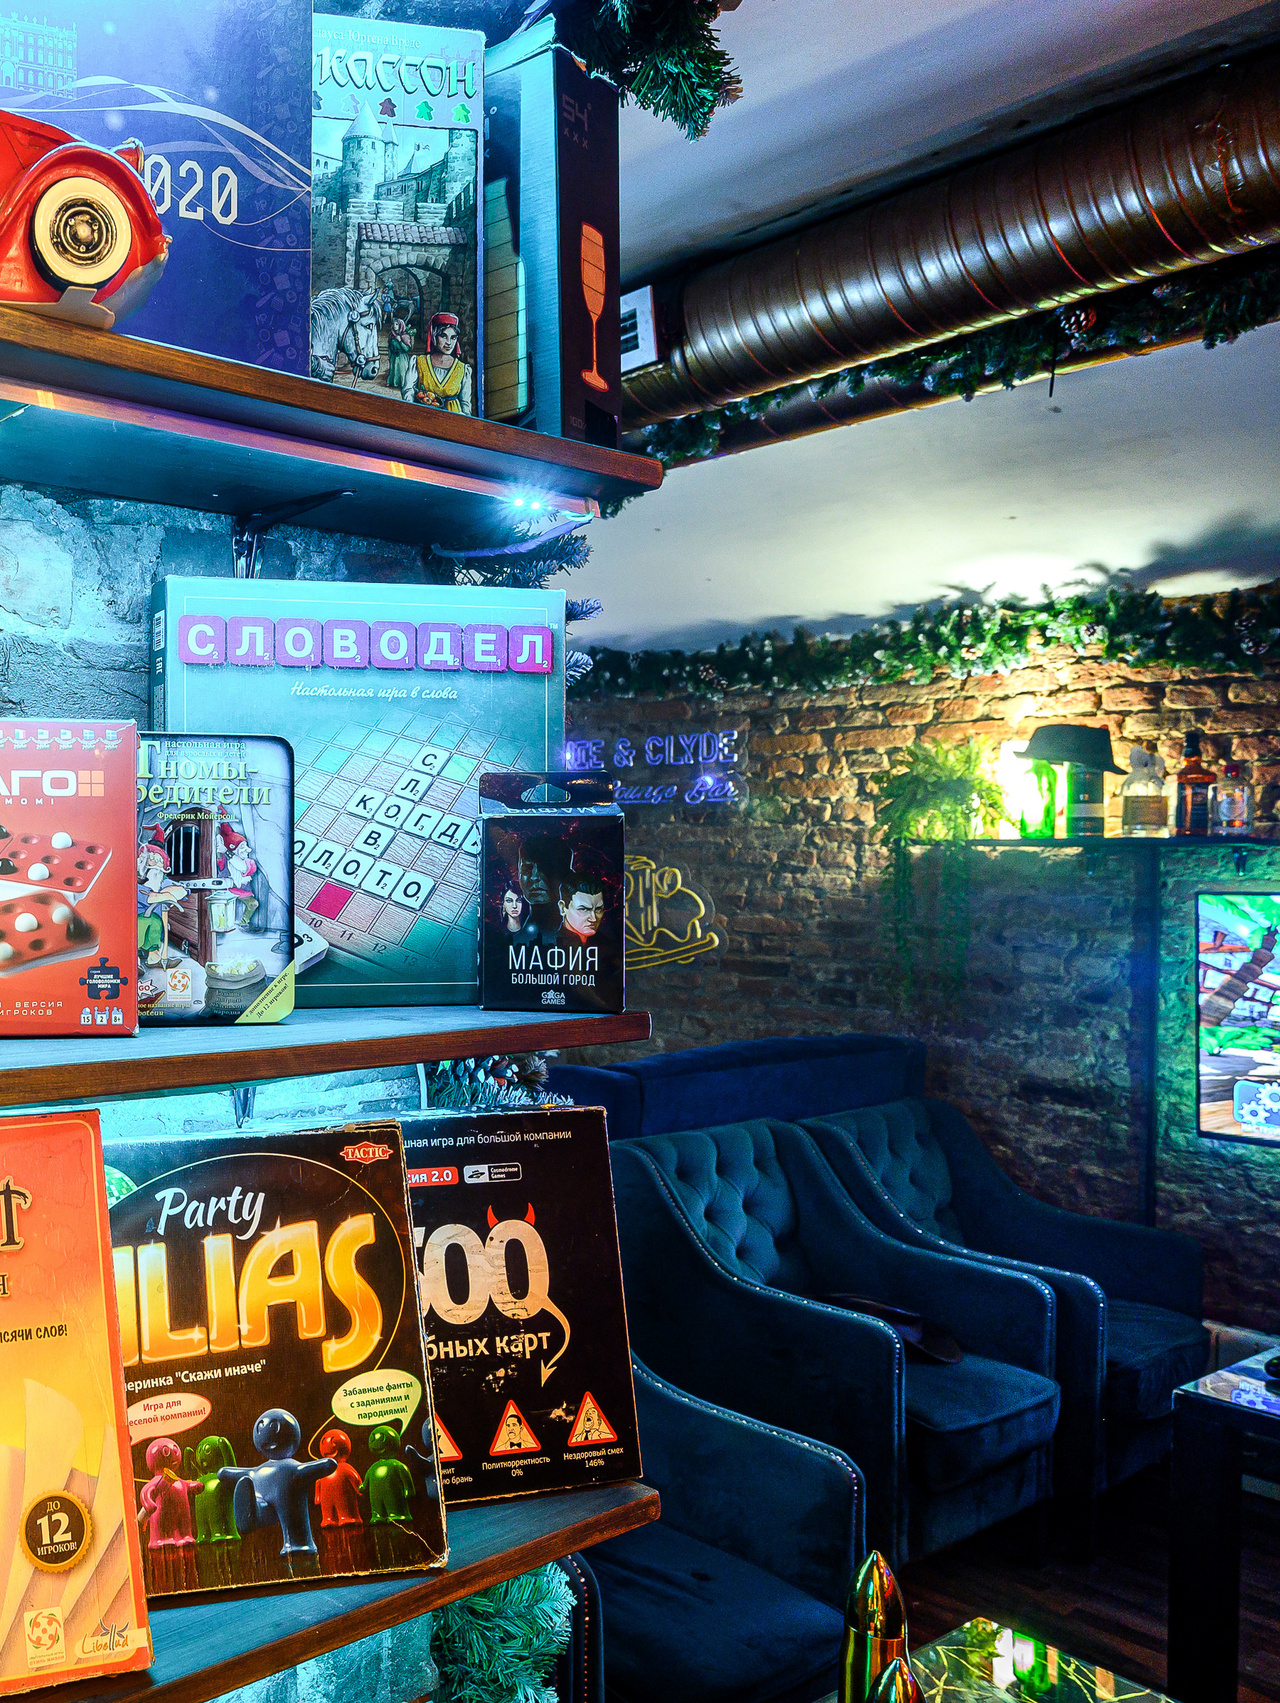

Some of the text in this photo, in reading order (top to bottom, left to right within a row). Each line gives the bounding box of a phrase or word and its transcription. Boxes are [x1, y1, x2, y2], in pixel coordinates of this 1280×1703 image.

[392, 34, 421, 49] Вреде
[186, 623, 553, 667] СЛОВОДЕЛ
[291, 680, 458, 703] Настольная игра в слова
[165, 740, 246, 750] настольная игра
[613, 730, 738, 768] & CLYDE
[685, 775, 739, 805] Bar
[157, 812, 196, 821] Фредерик
[308, 916, 323, 929] 10
[340, 930, 353, 942] 11
[372, 942, 388, 955] 12
[402, 953, 419, 968] 13
[508, 945, 600, 972] МАФИЯ
[511, 972, 596, 987] БОЛЬШОЙ ГОРОД
[82, 1015, 91, 1023] 15
[431, 1137, 455, 1149] игра
[457, 1136, 475, 1148] для
[477, 1131, 521, 1144] большой
[523, 1130, 572, 1142] компании
[346, 1146, 388, 1160] TACTIC
[430, 1169, 452, 1182] 2.0
[490, 1165, 519, 1174] Cosmodrome
[154, 1186, 266, 1240] Party
[36, 1322, 68, 1341] СЛОВ!
[495, 1330, 552, 1360] карт
[342, 1380, 414, 1398] Забавные фанты
[142, 1398, 182, 1413] Игра для
[356, 1396, 403, 1409] заданиями
[404, 1394, 410, 1402] и
[161, 1407, 207, 1423] компании!
[357, 1405, 409, 1421] пародиями!
[563, 1446, 624, 1461] Нездоровый смех
[481, 1456, 551, 1471] Политкорректность
[585, 1459, 605, 1468] 146%
[511, 1468, 524, 1477] 0%
[451, 1475, 474, 1486] брань
[46, 1500, 61, 1513] ДО
[36, 1512, 72, 1546] 12
[37, 1541, 77, 1556] ИГРОКОВ!
